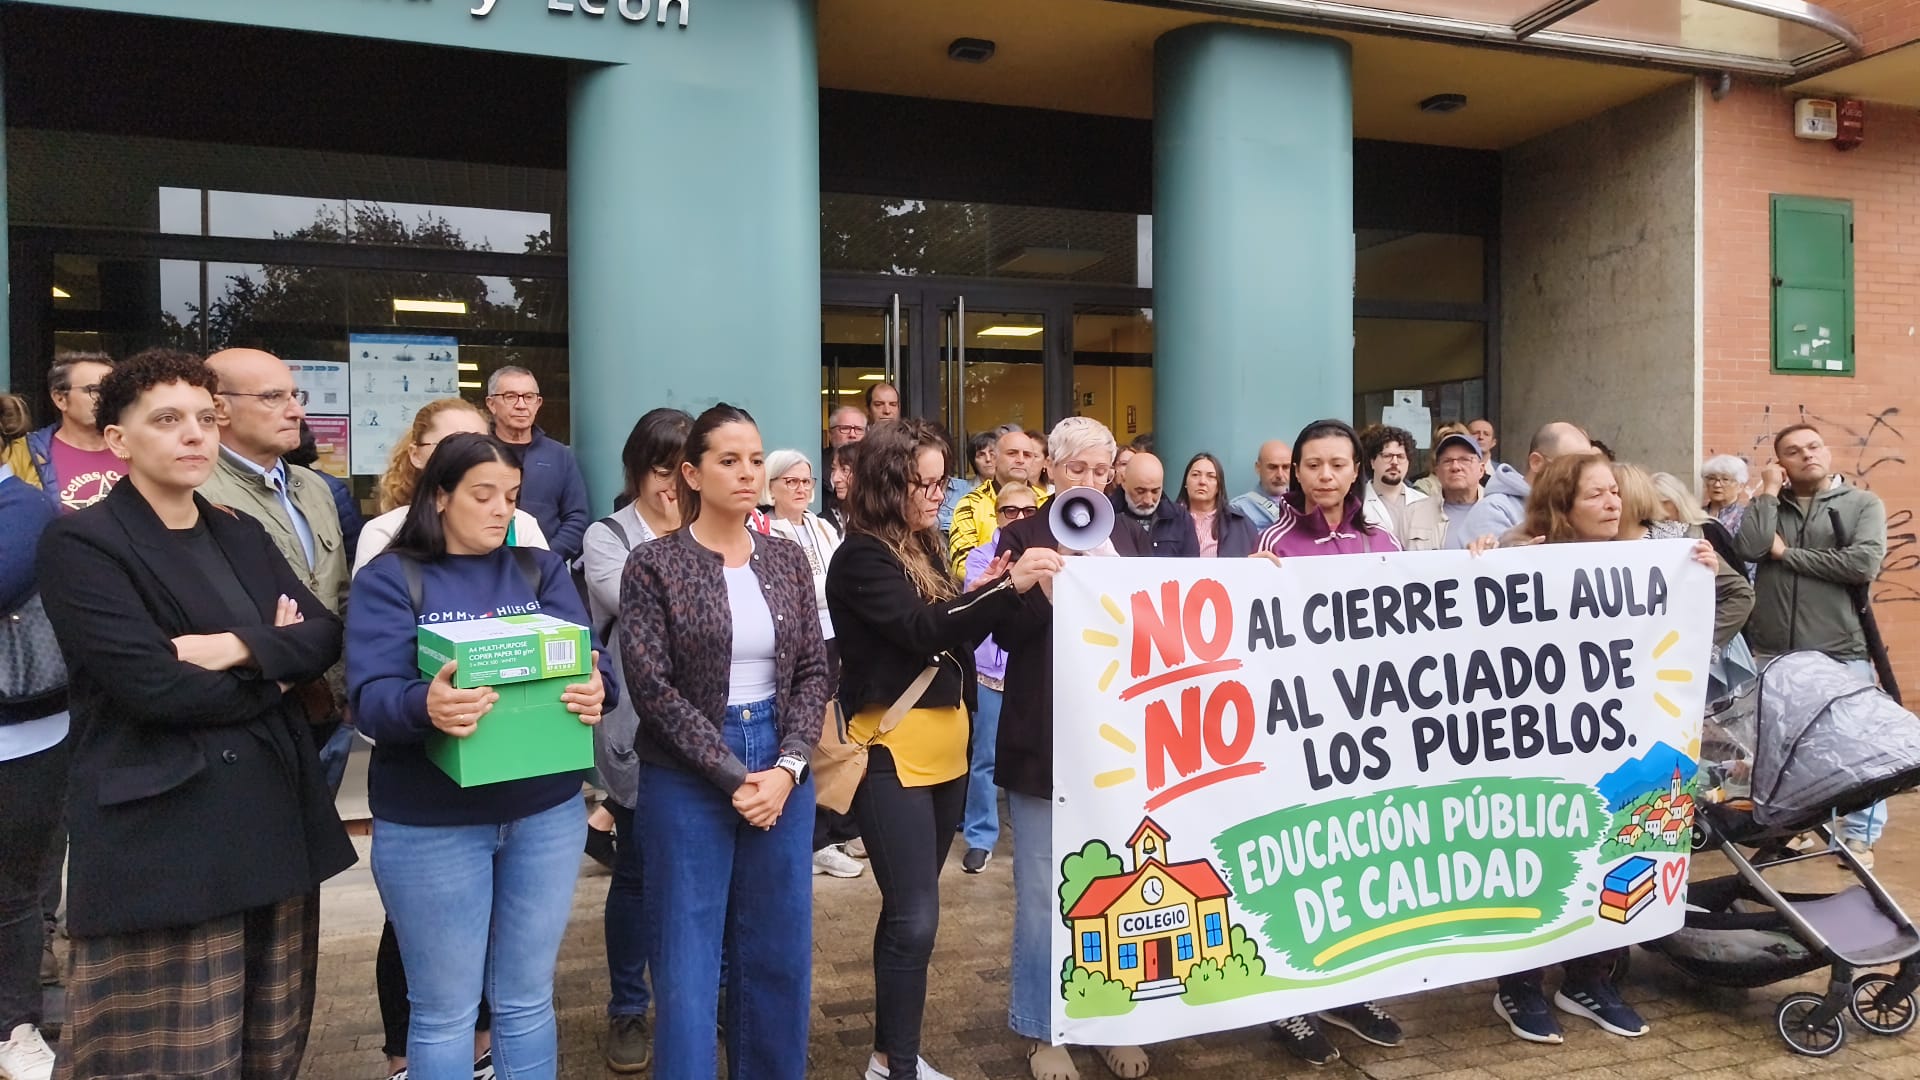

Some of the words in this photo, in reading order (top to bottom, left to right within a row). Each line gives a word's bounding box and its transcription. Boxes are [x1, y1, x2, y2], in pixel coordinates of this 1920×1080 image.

[60, 471, 102, 501] Celtas
[418, 611, 476, 624] TOMMY
[479, 641, 527, 652] MULTI-PURPOSE
[1131, 578, 1232, 678] NO
[1248, 597, 1296, 651] AL
[1304, 580, 1463, 645] CIERRE
[1475, 572, 1558, 627] DEL
[1570, 567, 1668, 618] AULA
[469, 653, 493, 661] COPIER
[494, 650, 513, 658] PAPER
[1145, 680, 1255, 790] NO
[1267, 676, 1324, 735] AL
[1333, 644, 1566, 720] VACIADO
[1580, 638, 1635, 692] DE
[1304, 726, 1391, 790] LOS
[1412, 699, 1637, 772] PUEBLOS.
[1238, 799, 1431, 894] EDUCACIÓN
[1443, 786, 1589, 842] PÚBLICA
[1123, 909, 1184, 932] COLEGIO
[1294, 876, 1352, 944] DE
[1358, 848, 1543, 923] CALIDAD
